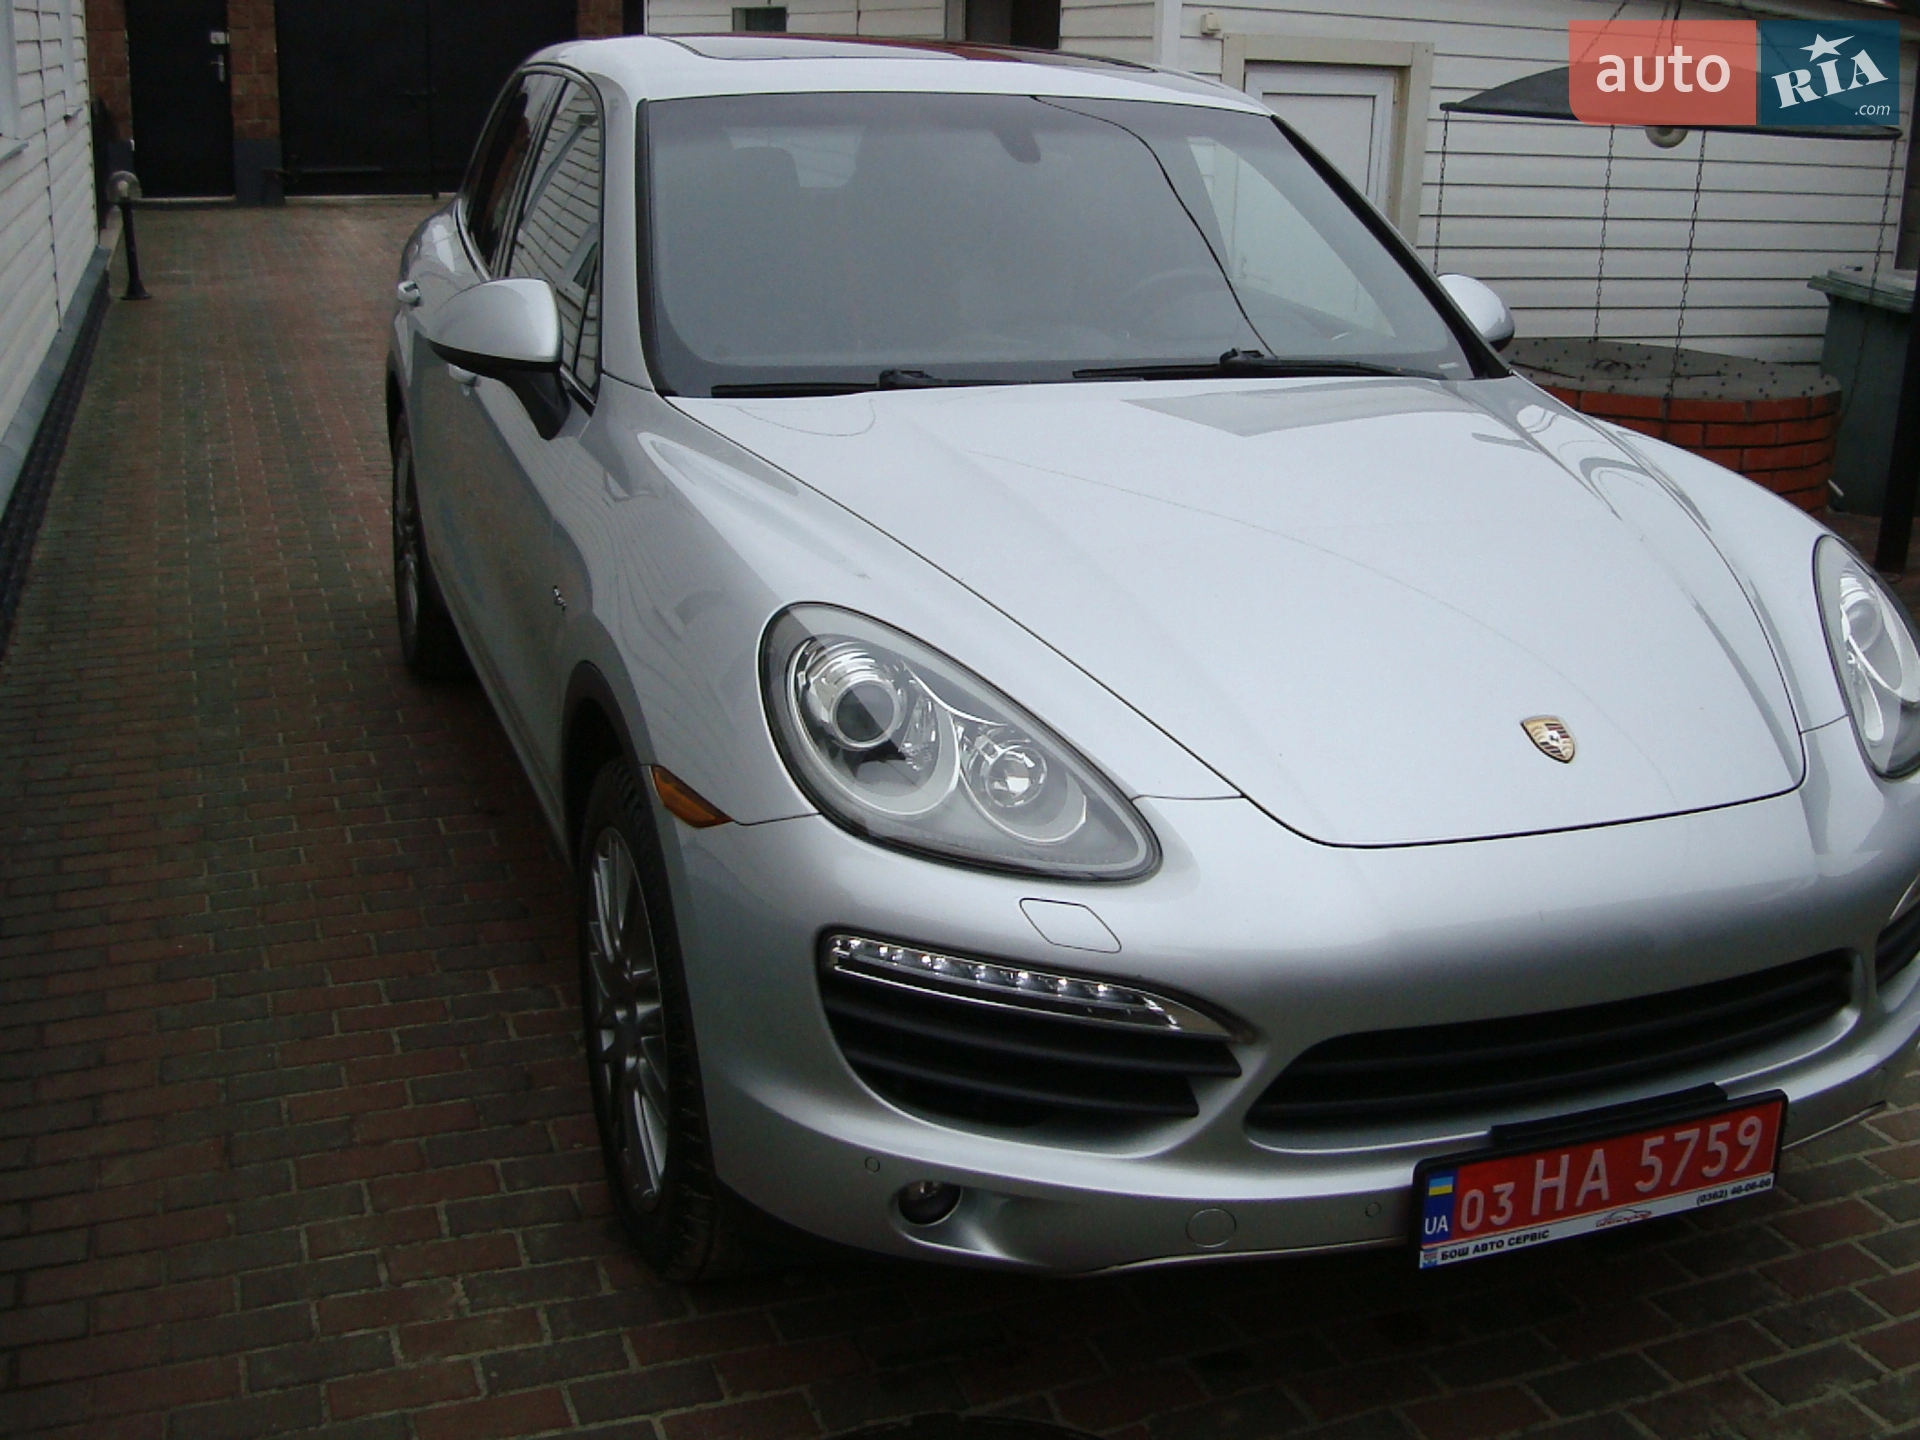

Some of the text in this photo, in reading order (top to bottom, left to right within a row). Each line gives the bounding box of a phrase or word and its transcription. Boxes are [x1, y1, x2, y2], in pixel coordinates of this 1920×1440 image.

[1460, 1115, 1763, 1231] 03 HA 5759
[1424, 1215, 1449, 1235] UA
[1441, 1230, 1550, 1260] БОШ АВТО СЕРВІС
